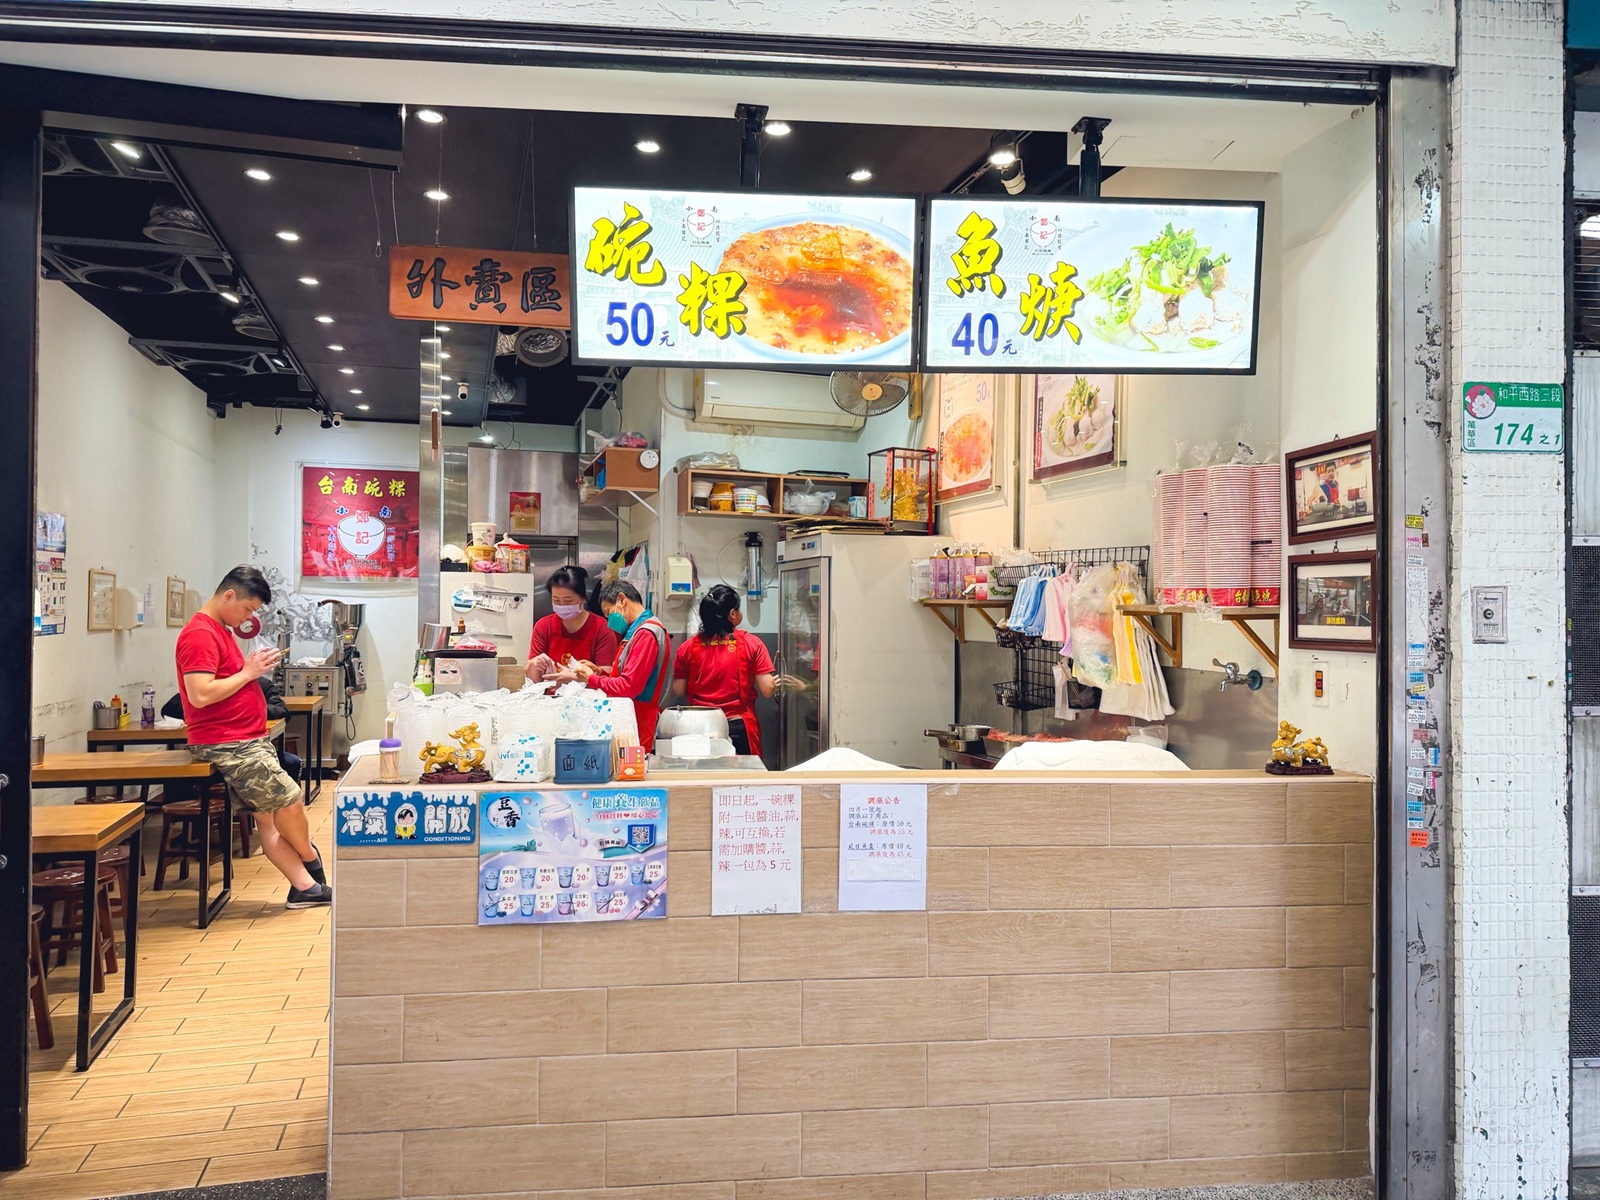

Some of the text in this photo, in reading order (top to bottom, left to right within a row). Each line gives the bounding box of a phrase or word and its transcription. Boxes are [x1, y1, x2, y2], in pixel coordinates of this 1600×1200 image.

[405, 256, 563, 315] 外賣區
[584, 201, 748, 340] 碗粿
[946, 210, 1085, 345] 魚焿
[1497, 386, 1561, 403] 和平西路三段
[317, 475, 406, 498] 台南碗粿
[340, 804, 472, 836] 冷氣 開放
[498, 795, 521, 828] 豆香
